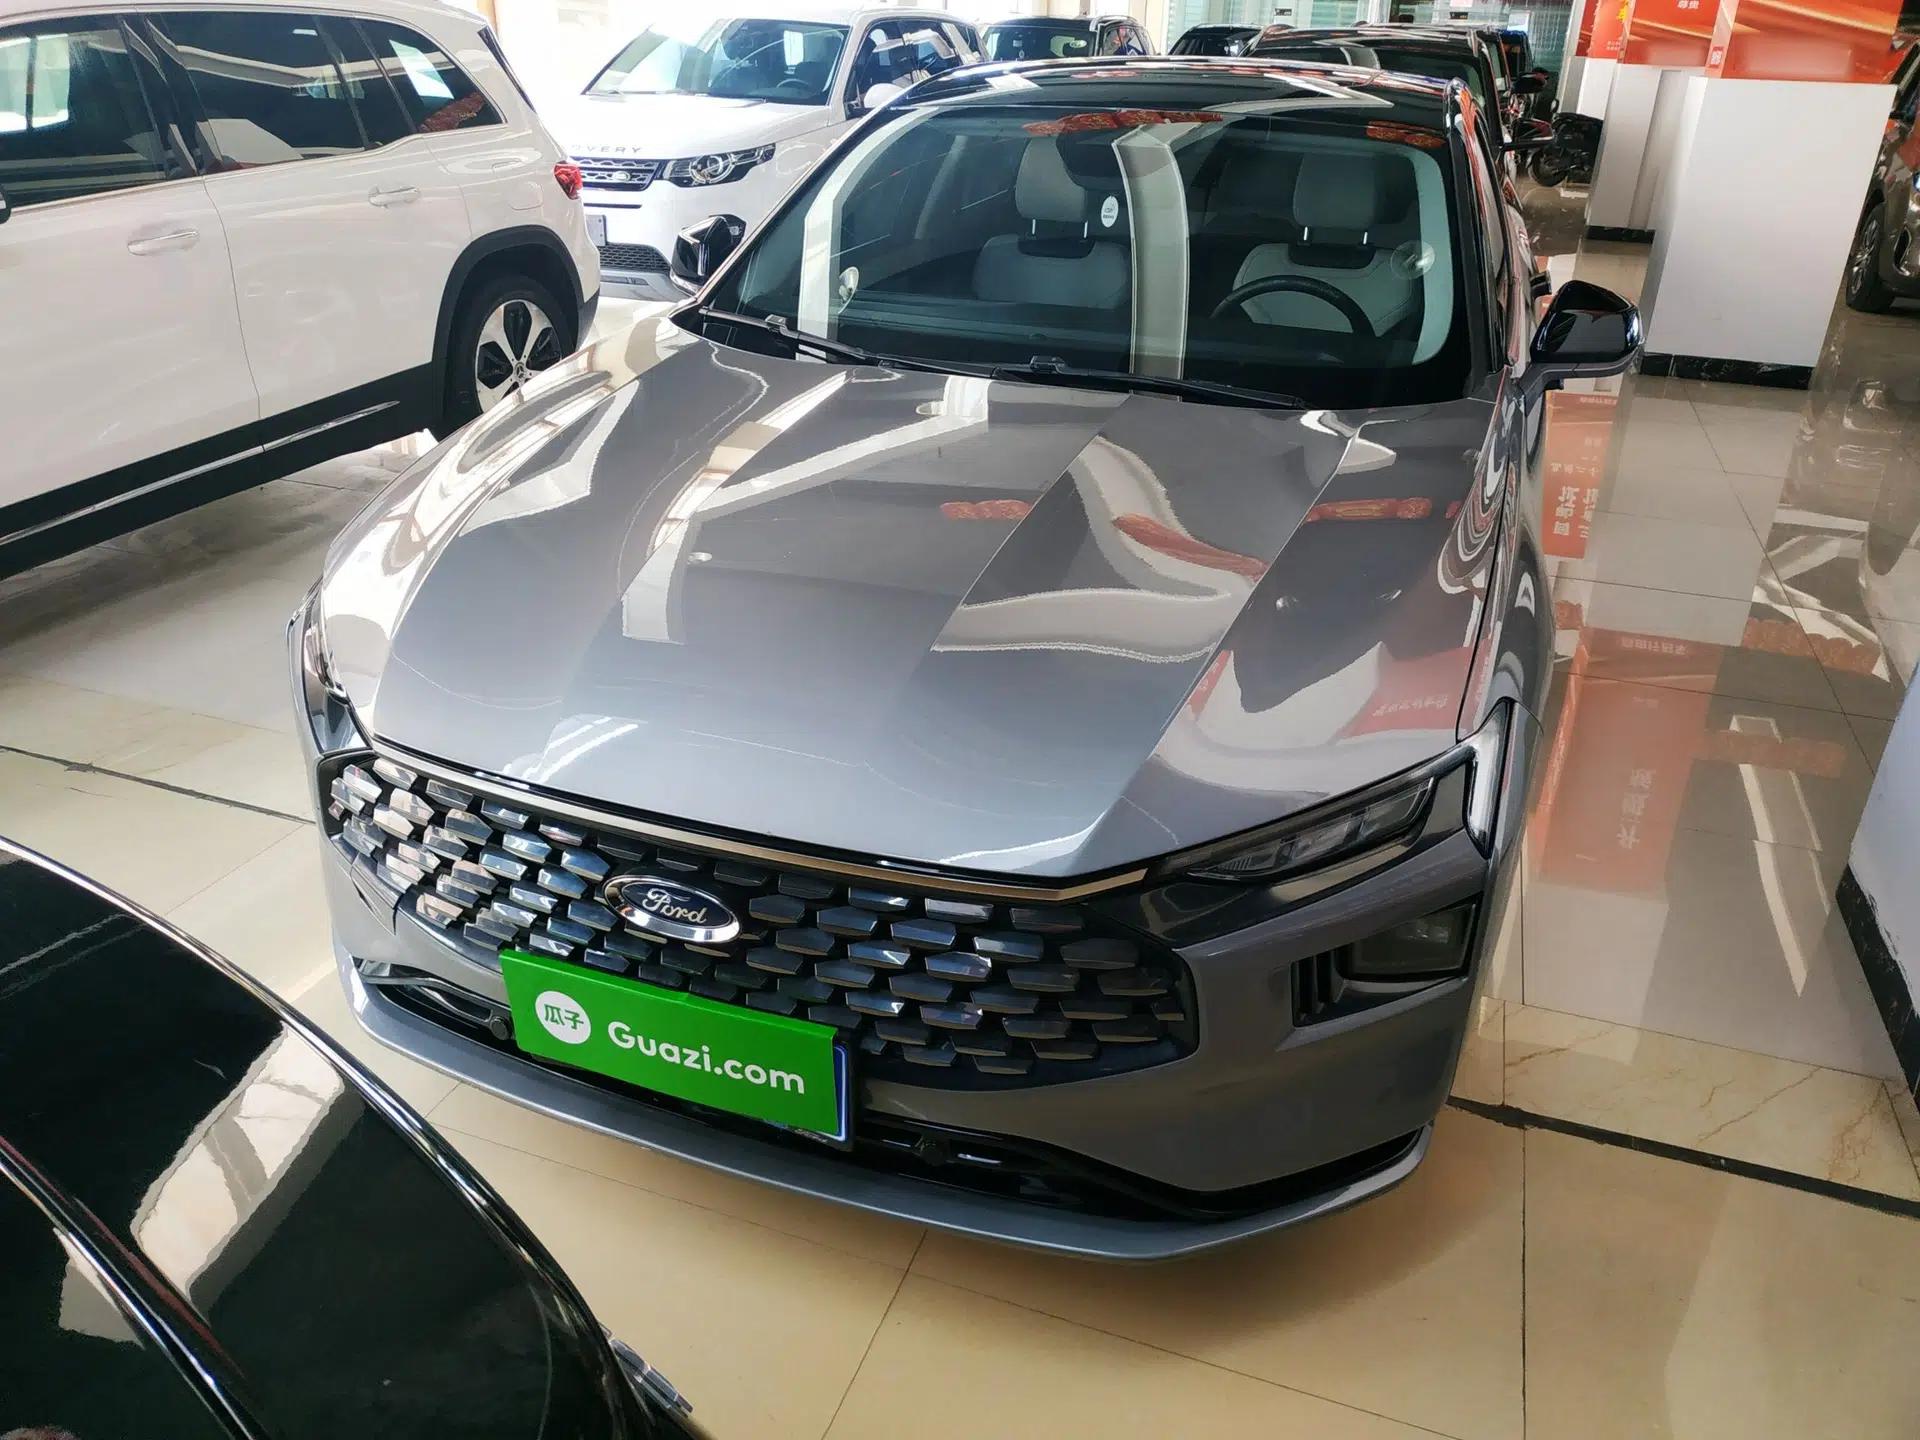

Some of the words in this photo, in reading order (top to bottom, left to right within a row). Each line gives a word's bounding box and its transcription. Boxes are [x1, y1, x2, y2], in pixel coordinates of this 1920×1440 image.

[642, 890, 706, 924] Ford
[545, 1004, 584, 1030] 瓜子
[607, 1021, 805, 1094] Guazi.com
